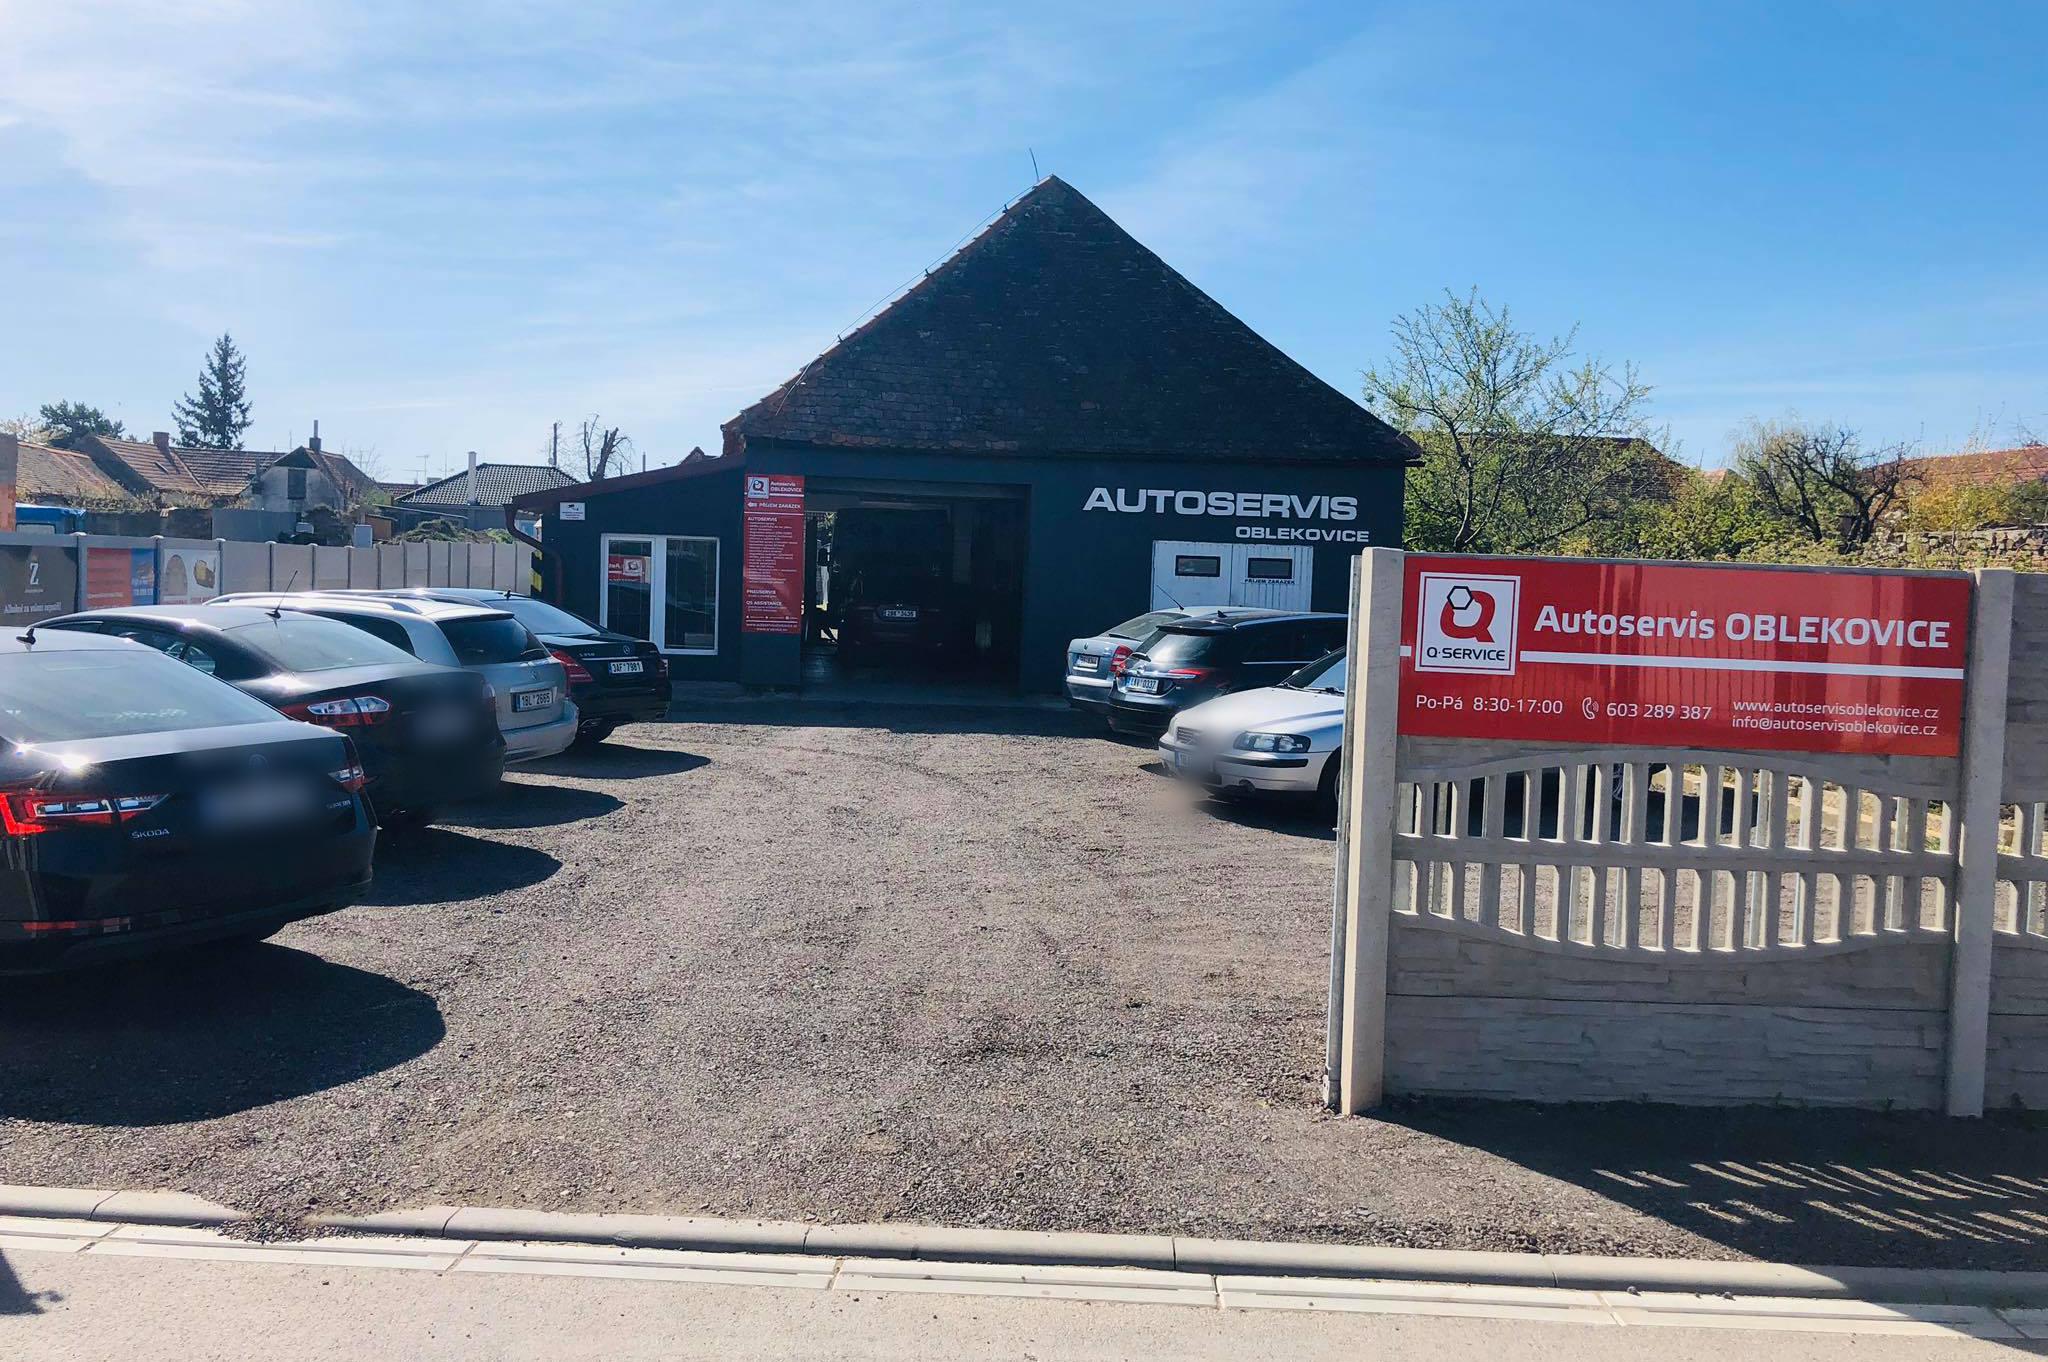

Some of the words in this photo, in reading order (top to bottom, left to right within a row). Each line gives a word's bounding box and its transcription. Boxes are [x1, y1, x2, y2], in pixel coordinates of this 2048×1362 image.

[1082, 487, 1358, 521] AUTOSERVIS
[1235, 526, 1370, 543] OBLEKOVICE
[1533, 605, 1715, 640] Autoservis
[1725, 612, 1951, 649] OBLEKOVICE
[1416, 695, 1463, 710] Po-Pá
[1473, 697, 1563, 714] 8:30-17:00
[1606, 703, 1639, 718] 603
[1643, 704, 1676, 719] 289
[1680, 705, 1713, 720] 387
[1733, 701, 1939, 719] www.autoservisoblekovice.cz
[1732, 715, 1938, 736] info@autoservisoblekovice.cz
